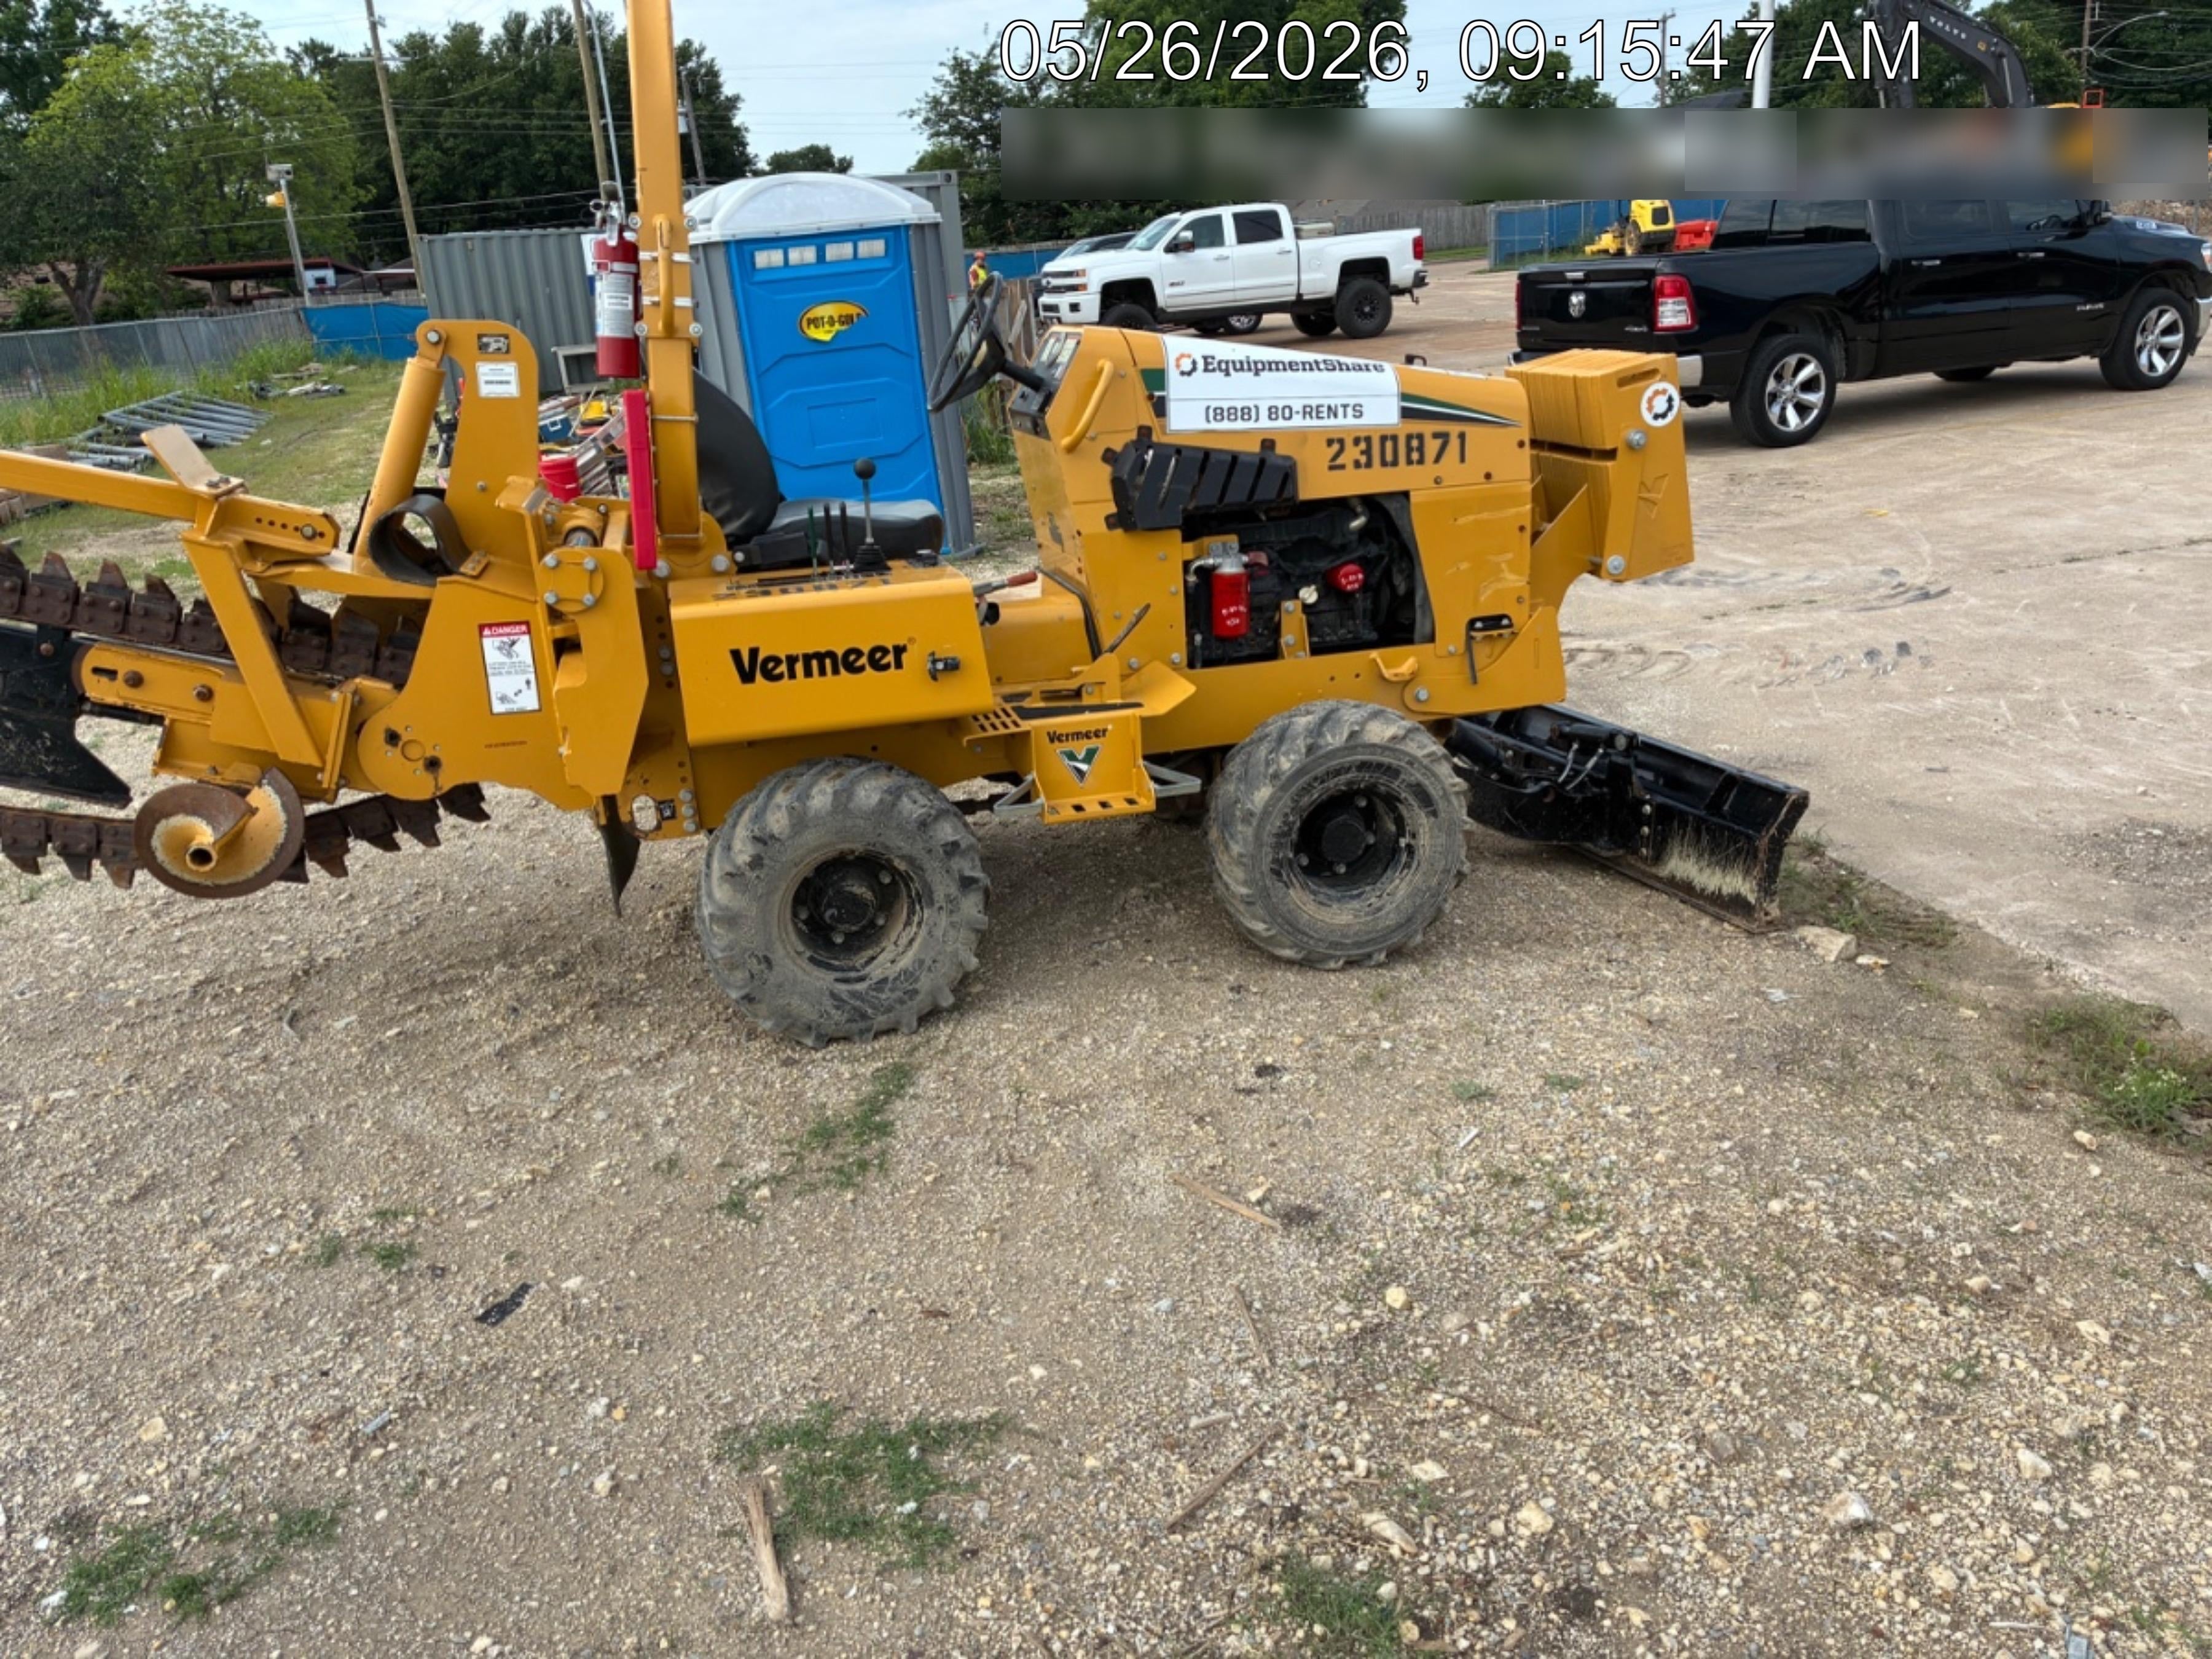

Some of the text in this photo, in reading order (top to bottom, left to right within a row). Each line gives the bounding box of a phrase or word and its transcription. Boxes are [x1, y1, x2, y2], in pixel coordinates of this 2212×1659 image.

[1201, 355, 1386, 377] EquipmentShare
[1205, 403, 1363, 423] (888) 80-RENTS
[1326, 431, 1467, 471] 230871
[492, 624, 527, 635] DANGER
[729, 643, 908, 685] Vermeer
[1046, 727, 1108, 744] Vermeer
